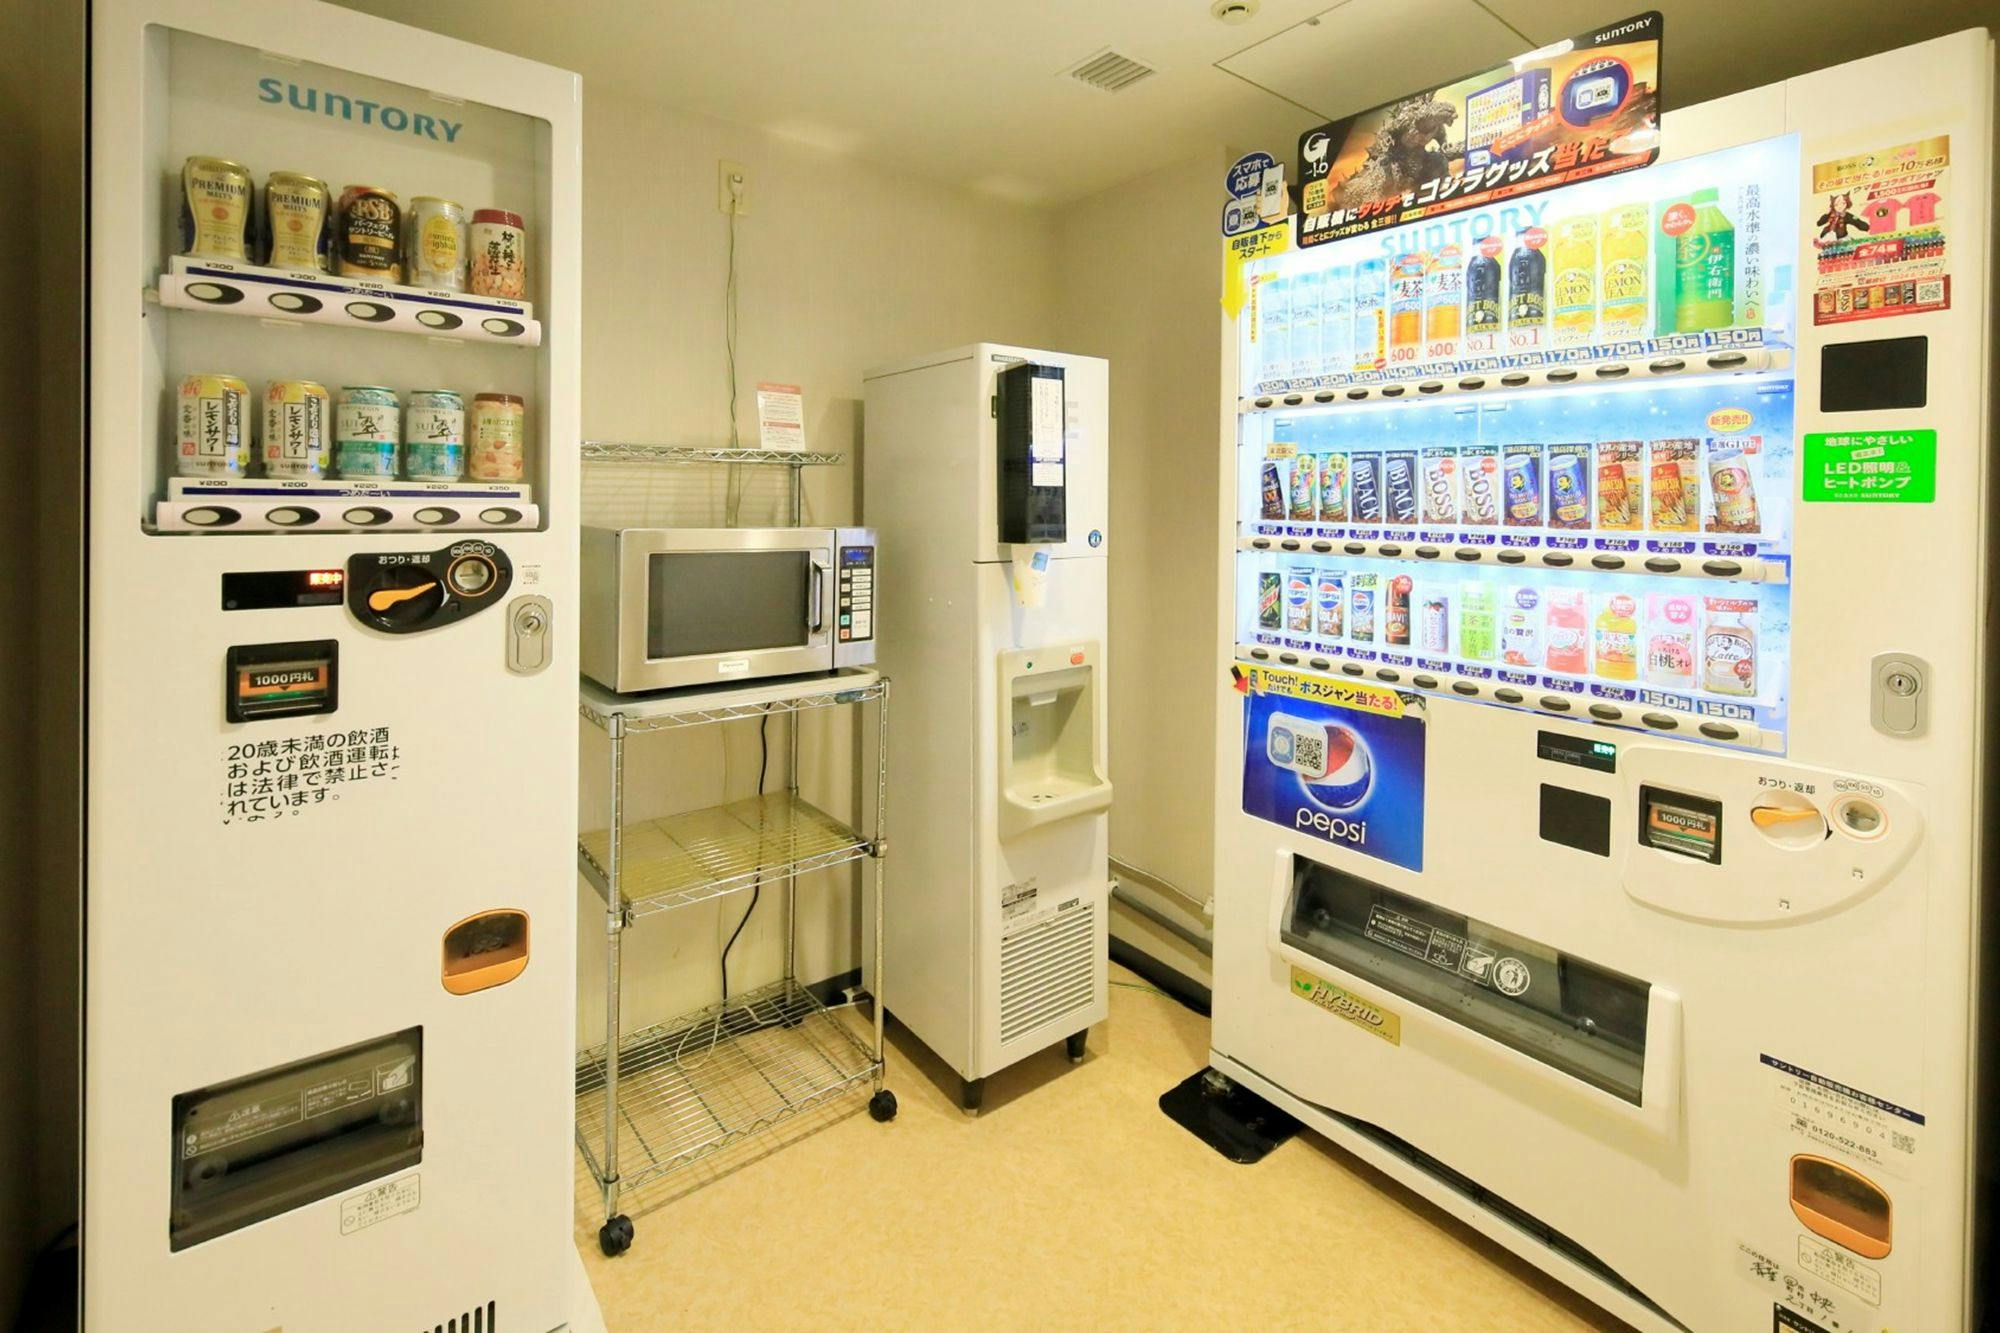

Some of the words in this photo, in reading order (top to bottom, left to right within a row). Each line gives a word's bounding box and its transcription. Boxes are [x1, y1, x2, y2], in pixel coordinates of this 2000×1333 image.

[1595, 17, 1653, 44] SUNTORY
[1232, 158, 1270, 178] スマホで
[192, 177, 247, 196] PREMIUM
[271, 192, 322, 208] PREMIUM
[1239, 245, 1271, 260] スタート
[1400, 281, 1424, 298] 麦茶
[1438, 273, 1462, 291] 麦茶
[1648, 334, 1699, 352] 150円
[1707, 327, 1762, 346] 150円
[1546, 349, 1591, 363] 170円
[1595, 342, 1642, 357] 170円
[1503, 352, 1543, 368] 170円
[204, 401, 221, 453] レモンサワー
[288, 406, 304, 456] レモンサワー
[1824, 435, 1914, 447] 地球にやさしい
[1355, 463, 1380, 519] BLACK
[1390, 462, 1415, 521] BLACK
[1429, 468, 1454, 516] BOSS
[1469, 466, 1495, 517] BOSS
[1824, 476, 1912, 489] ヒートポンプ
[378, 555, 431, 565] おつり・返却
[1262, 669, 1299, 687] Touch!
[1299, 680, 1399, 711] ボスジャン当たる!
[1641, 689, 1692, 711] 150円
[1699, 700, 1754, 720] 150円
[228, 727, 389, 761] 20歳未満の飲酒
[228, 745, 389, 780] および飲酒運転
[228, 762, 389, 798] は法律で禁止さ
[1758, 776, 1816, 795] おつり・返却
[228, 787, 340, 816] れています。
[1295, 807, 1367, 845] pepsi
